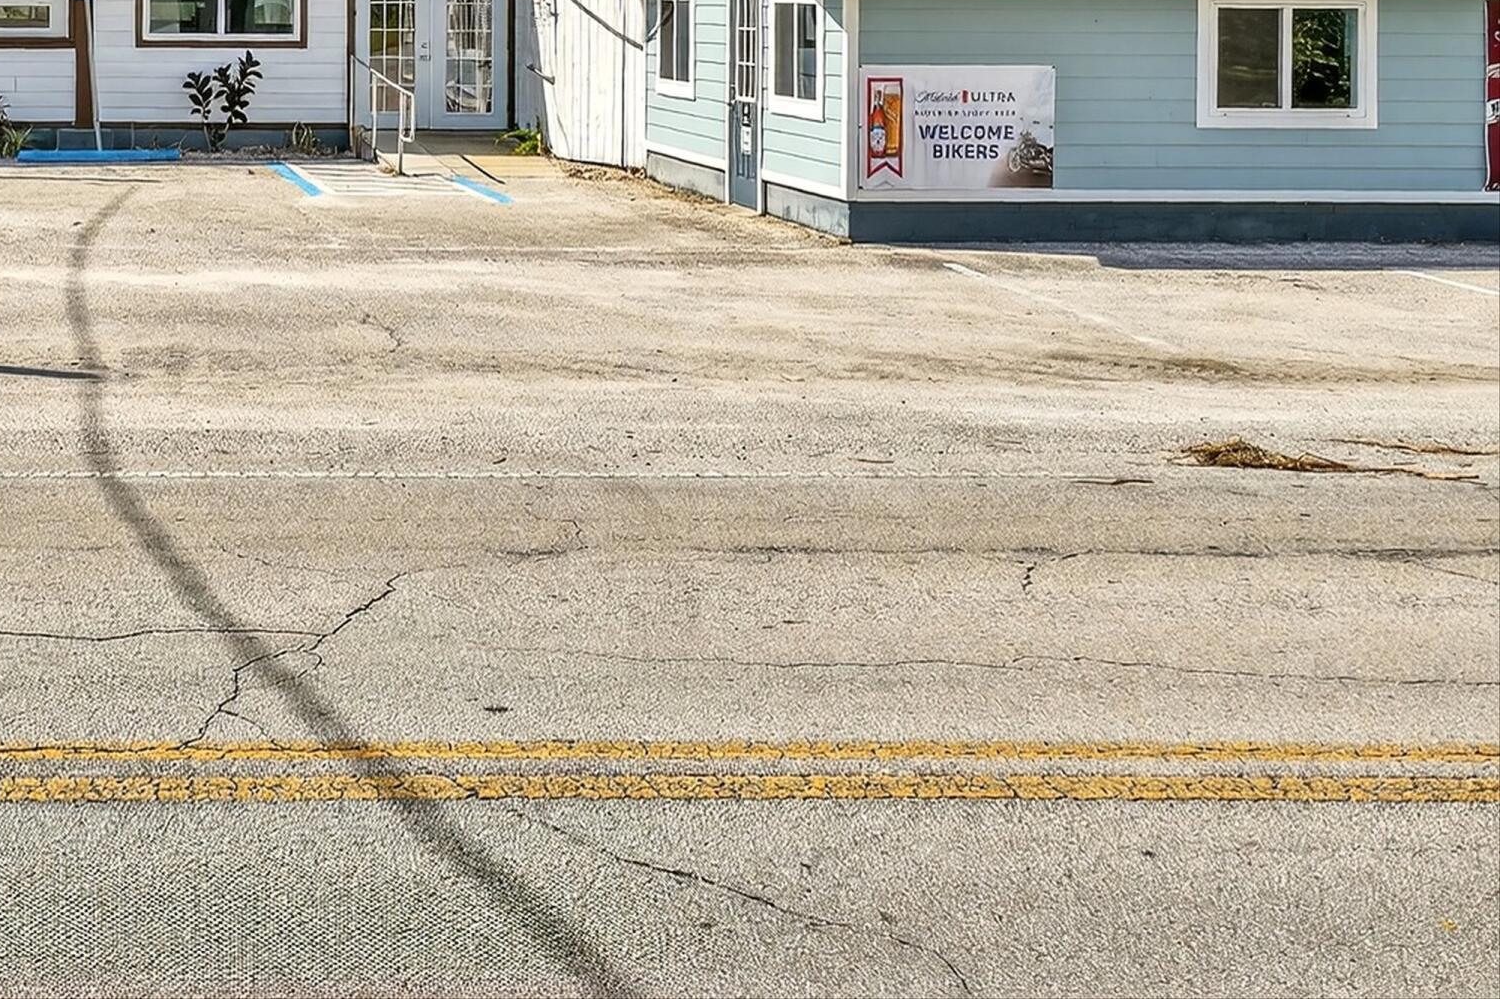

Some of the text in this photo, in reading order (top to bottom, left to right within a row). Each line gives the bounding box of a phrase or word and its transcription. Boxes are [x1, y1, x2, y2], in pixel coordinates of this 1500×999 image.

[970, 91, 1016, 103] ULTRA
[918, 124, 1015, 140] WELCOME
[932, 144, 1000, 159] BIKERS
